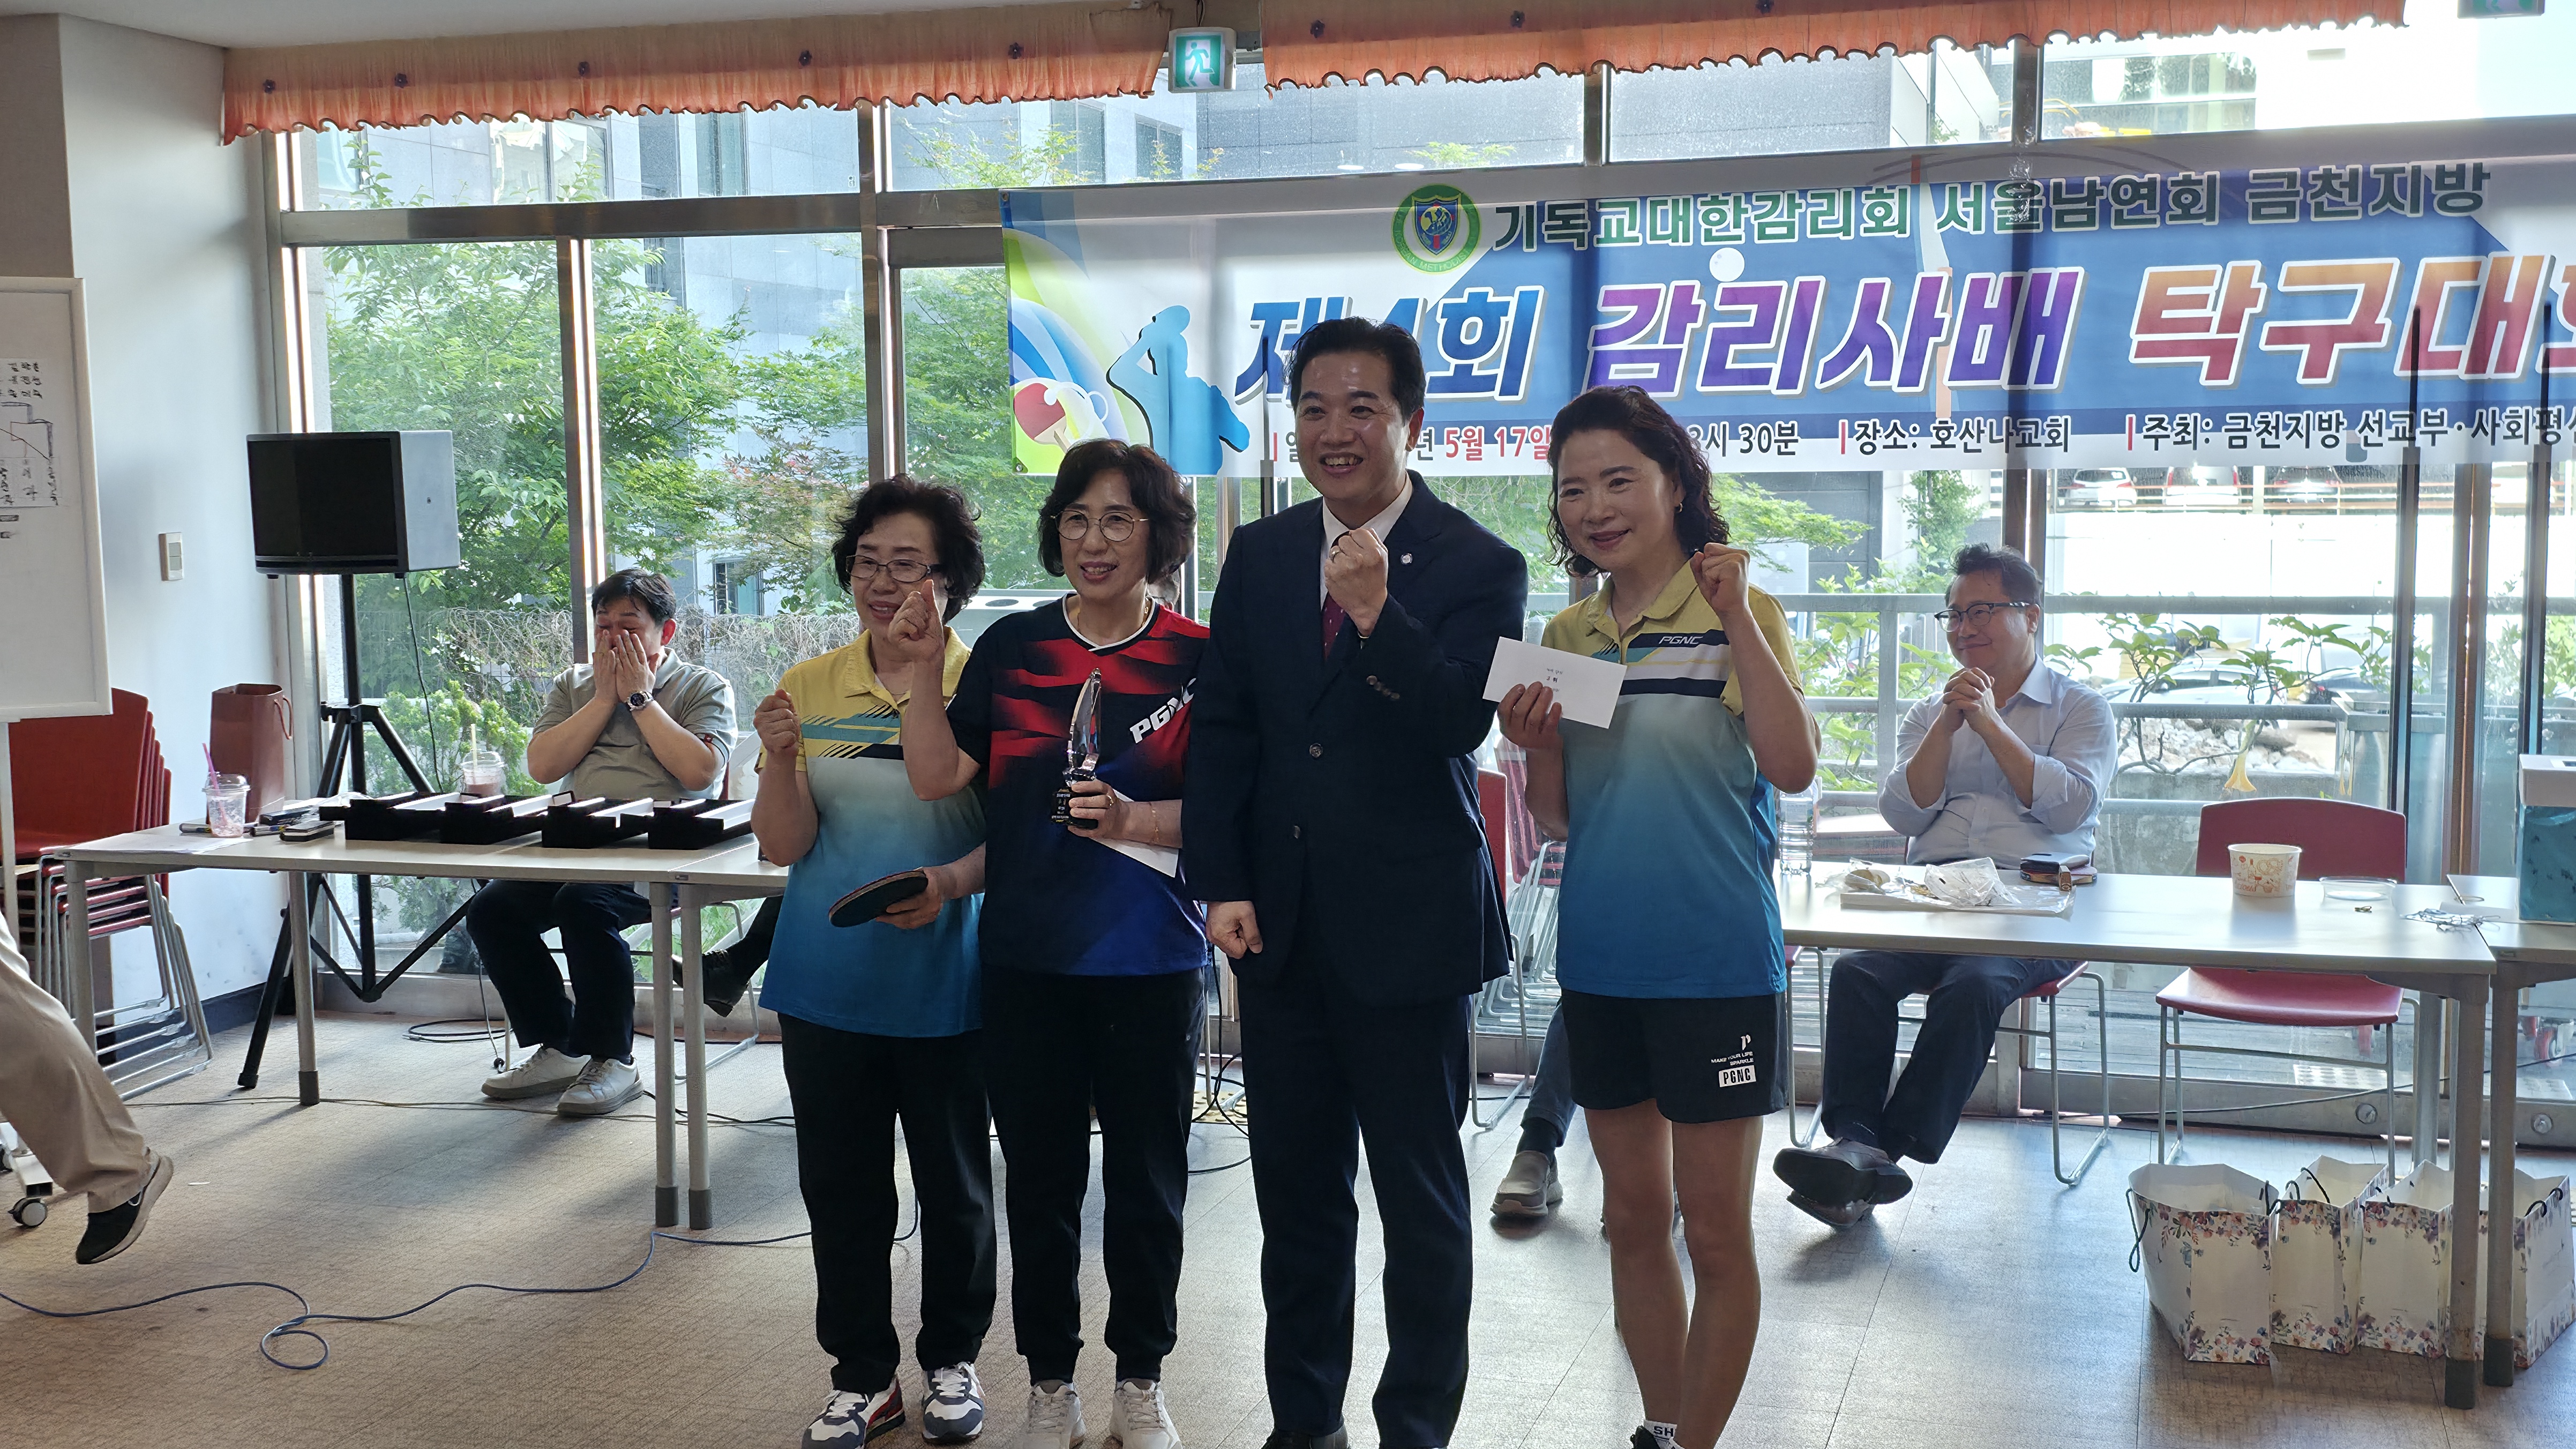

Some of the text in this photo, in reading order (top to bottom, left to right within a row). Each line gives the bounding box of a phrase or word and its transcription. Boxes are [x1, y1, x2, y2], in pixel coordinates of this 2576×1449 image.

[1493, 186, 1909, 251] 기독교대한감리회
[1935, 172, 2219, 234] 서울남연회
[2246, 162, 2490, 223] 금천지방
[1584, 267, 2084, 395] 감리사배
[2130, 255, 2576, 385] 탁구대
[1446, 428, 1482, 461] 5월
[1739, 423, 1799, 455] 30분
[1854, 420, 1918, 455] 장소:
[1930, 416, 2070, 453] 호산나교회
[2143, 415, 2210, 451] 주최:
[2222, 410, 2345, 449] 금천지방
[1658, 636, 1704, 644] PGNC
[1723, 1068, 1751, 1084] PGNC
[1730, 1058, 1754, 1066] SPARKLE
